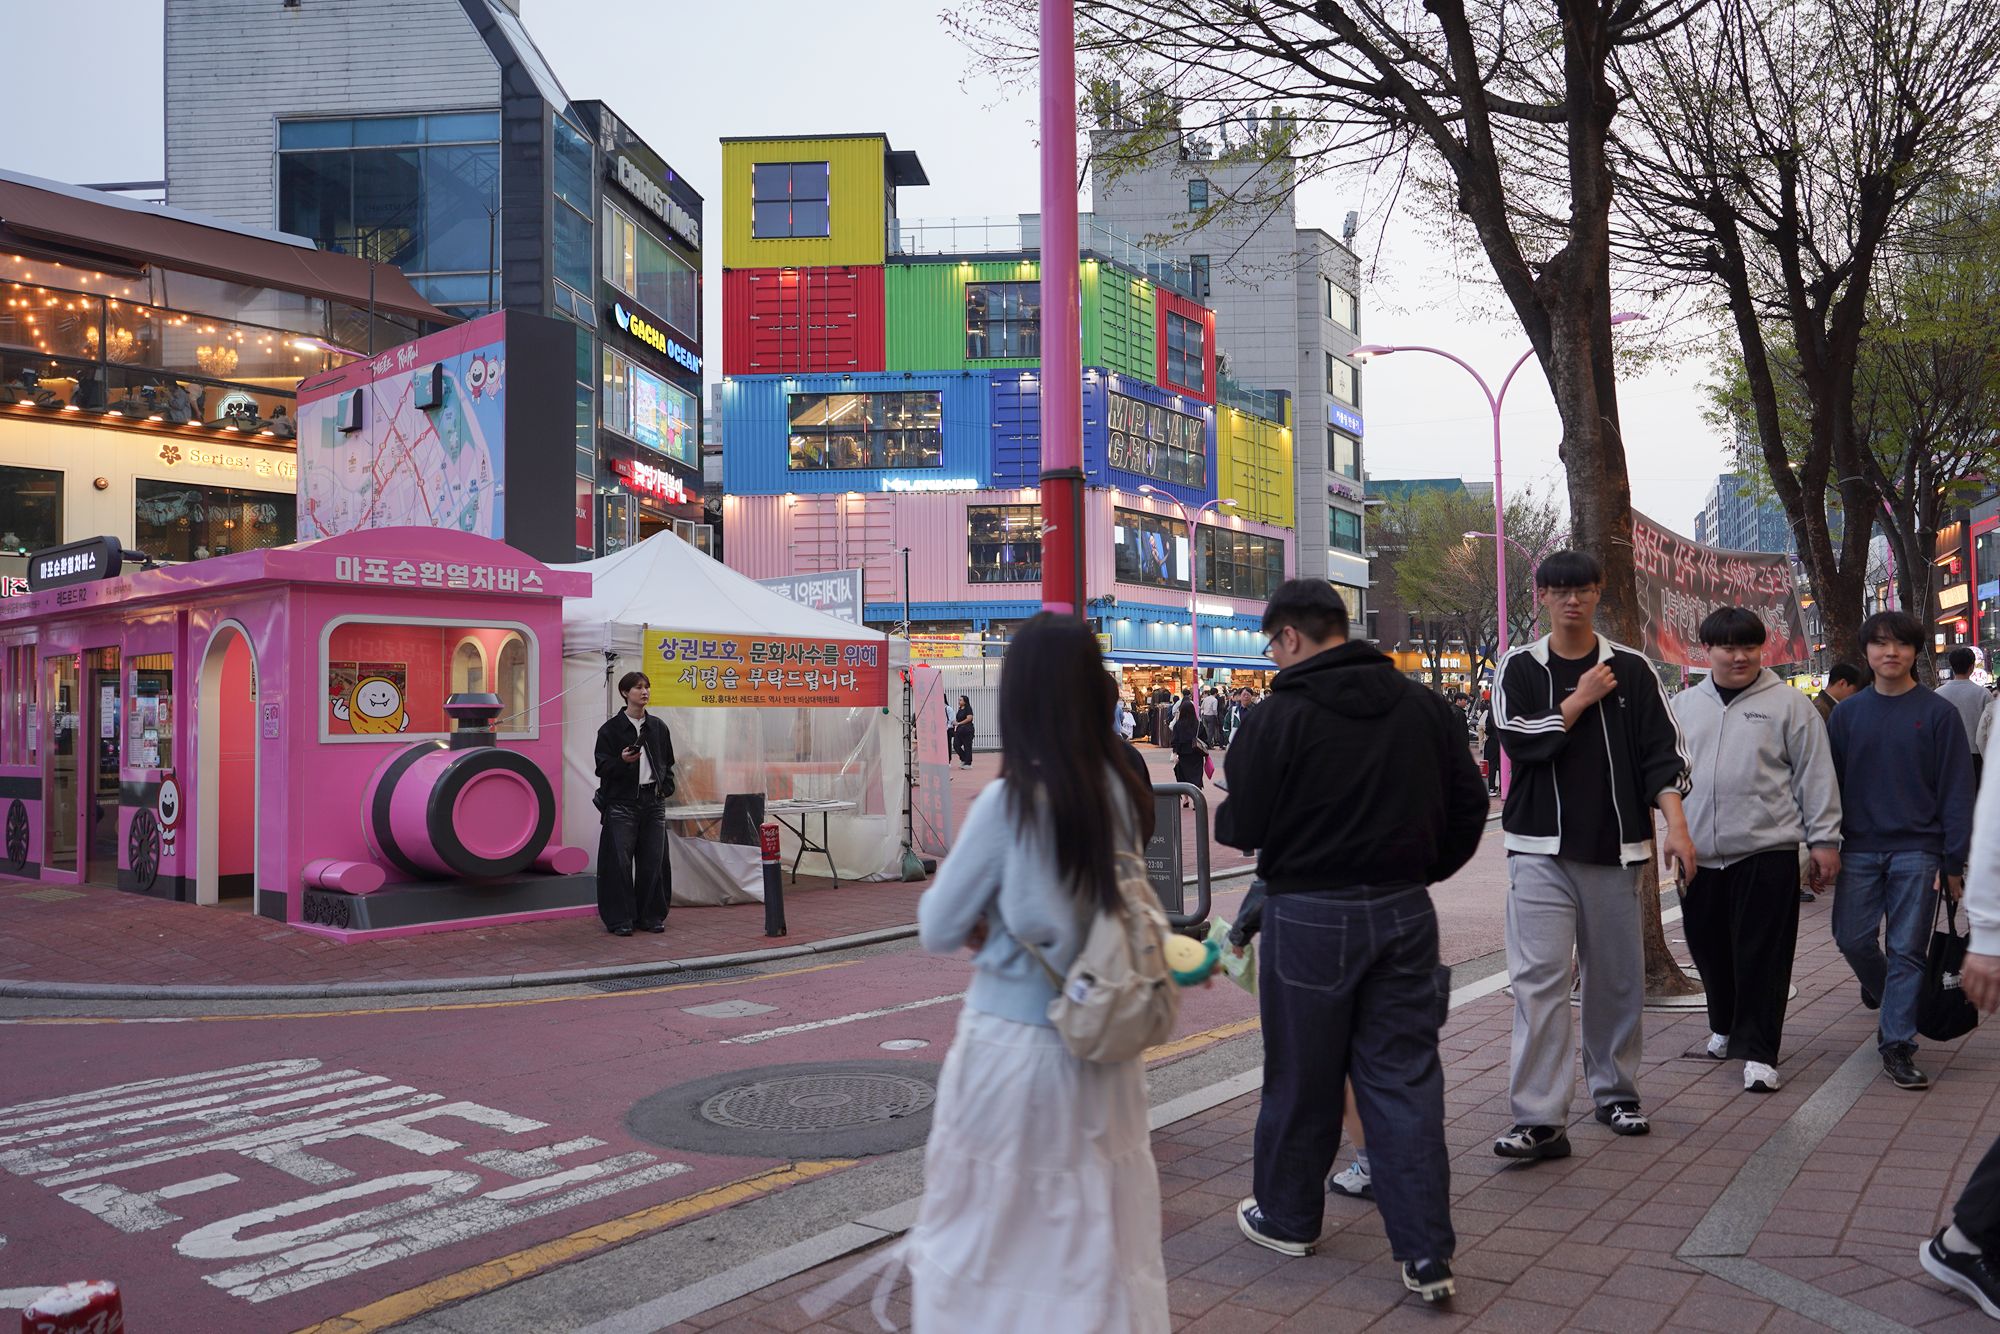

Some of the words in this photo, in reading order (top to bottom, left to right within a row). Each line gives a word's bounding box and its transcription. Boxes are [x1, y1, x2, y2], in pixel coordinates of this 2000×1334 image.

[630, 314, 666, 355] GACHA
[190, 449, 250, 468] Series:
[1109, 431, 1158, 476] GRO
[40, 551, 96, 580] 마포순환열차버스
[335, 556, 544, 593] 마포순환열차버스
[56, 589, 78, 606] 레드로드
[79, 588, 87, 602] R2
[657, 637, 744, 664] 상권보호,
[748, 642, 840, 666] 문화사수를
[844, 645, 878, 668] 위해
[678, 666, 740, 690] 서명을
[747, 668, 859, 692] 부탁드립니다.
[740, 695, 766, 704] 레드로드
[768, 696, 781, 704] 역사
[784, 696, 796, 704] 반대
[798, 696, 840, 704] 비상대책위원회
